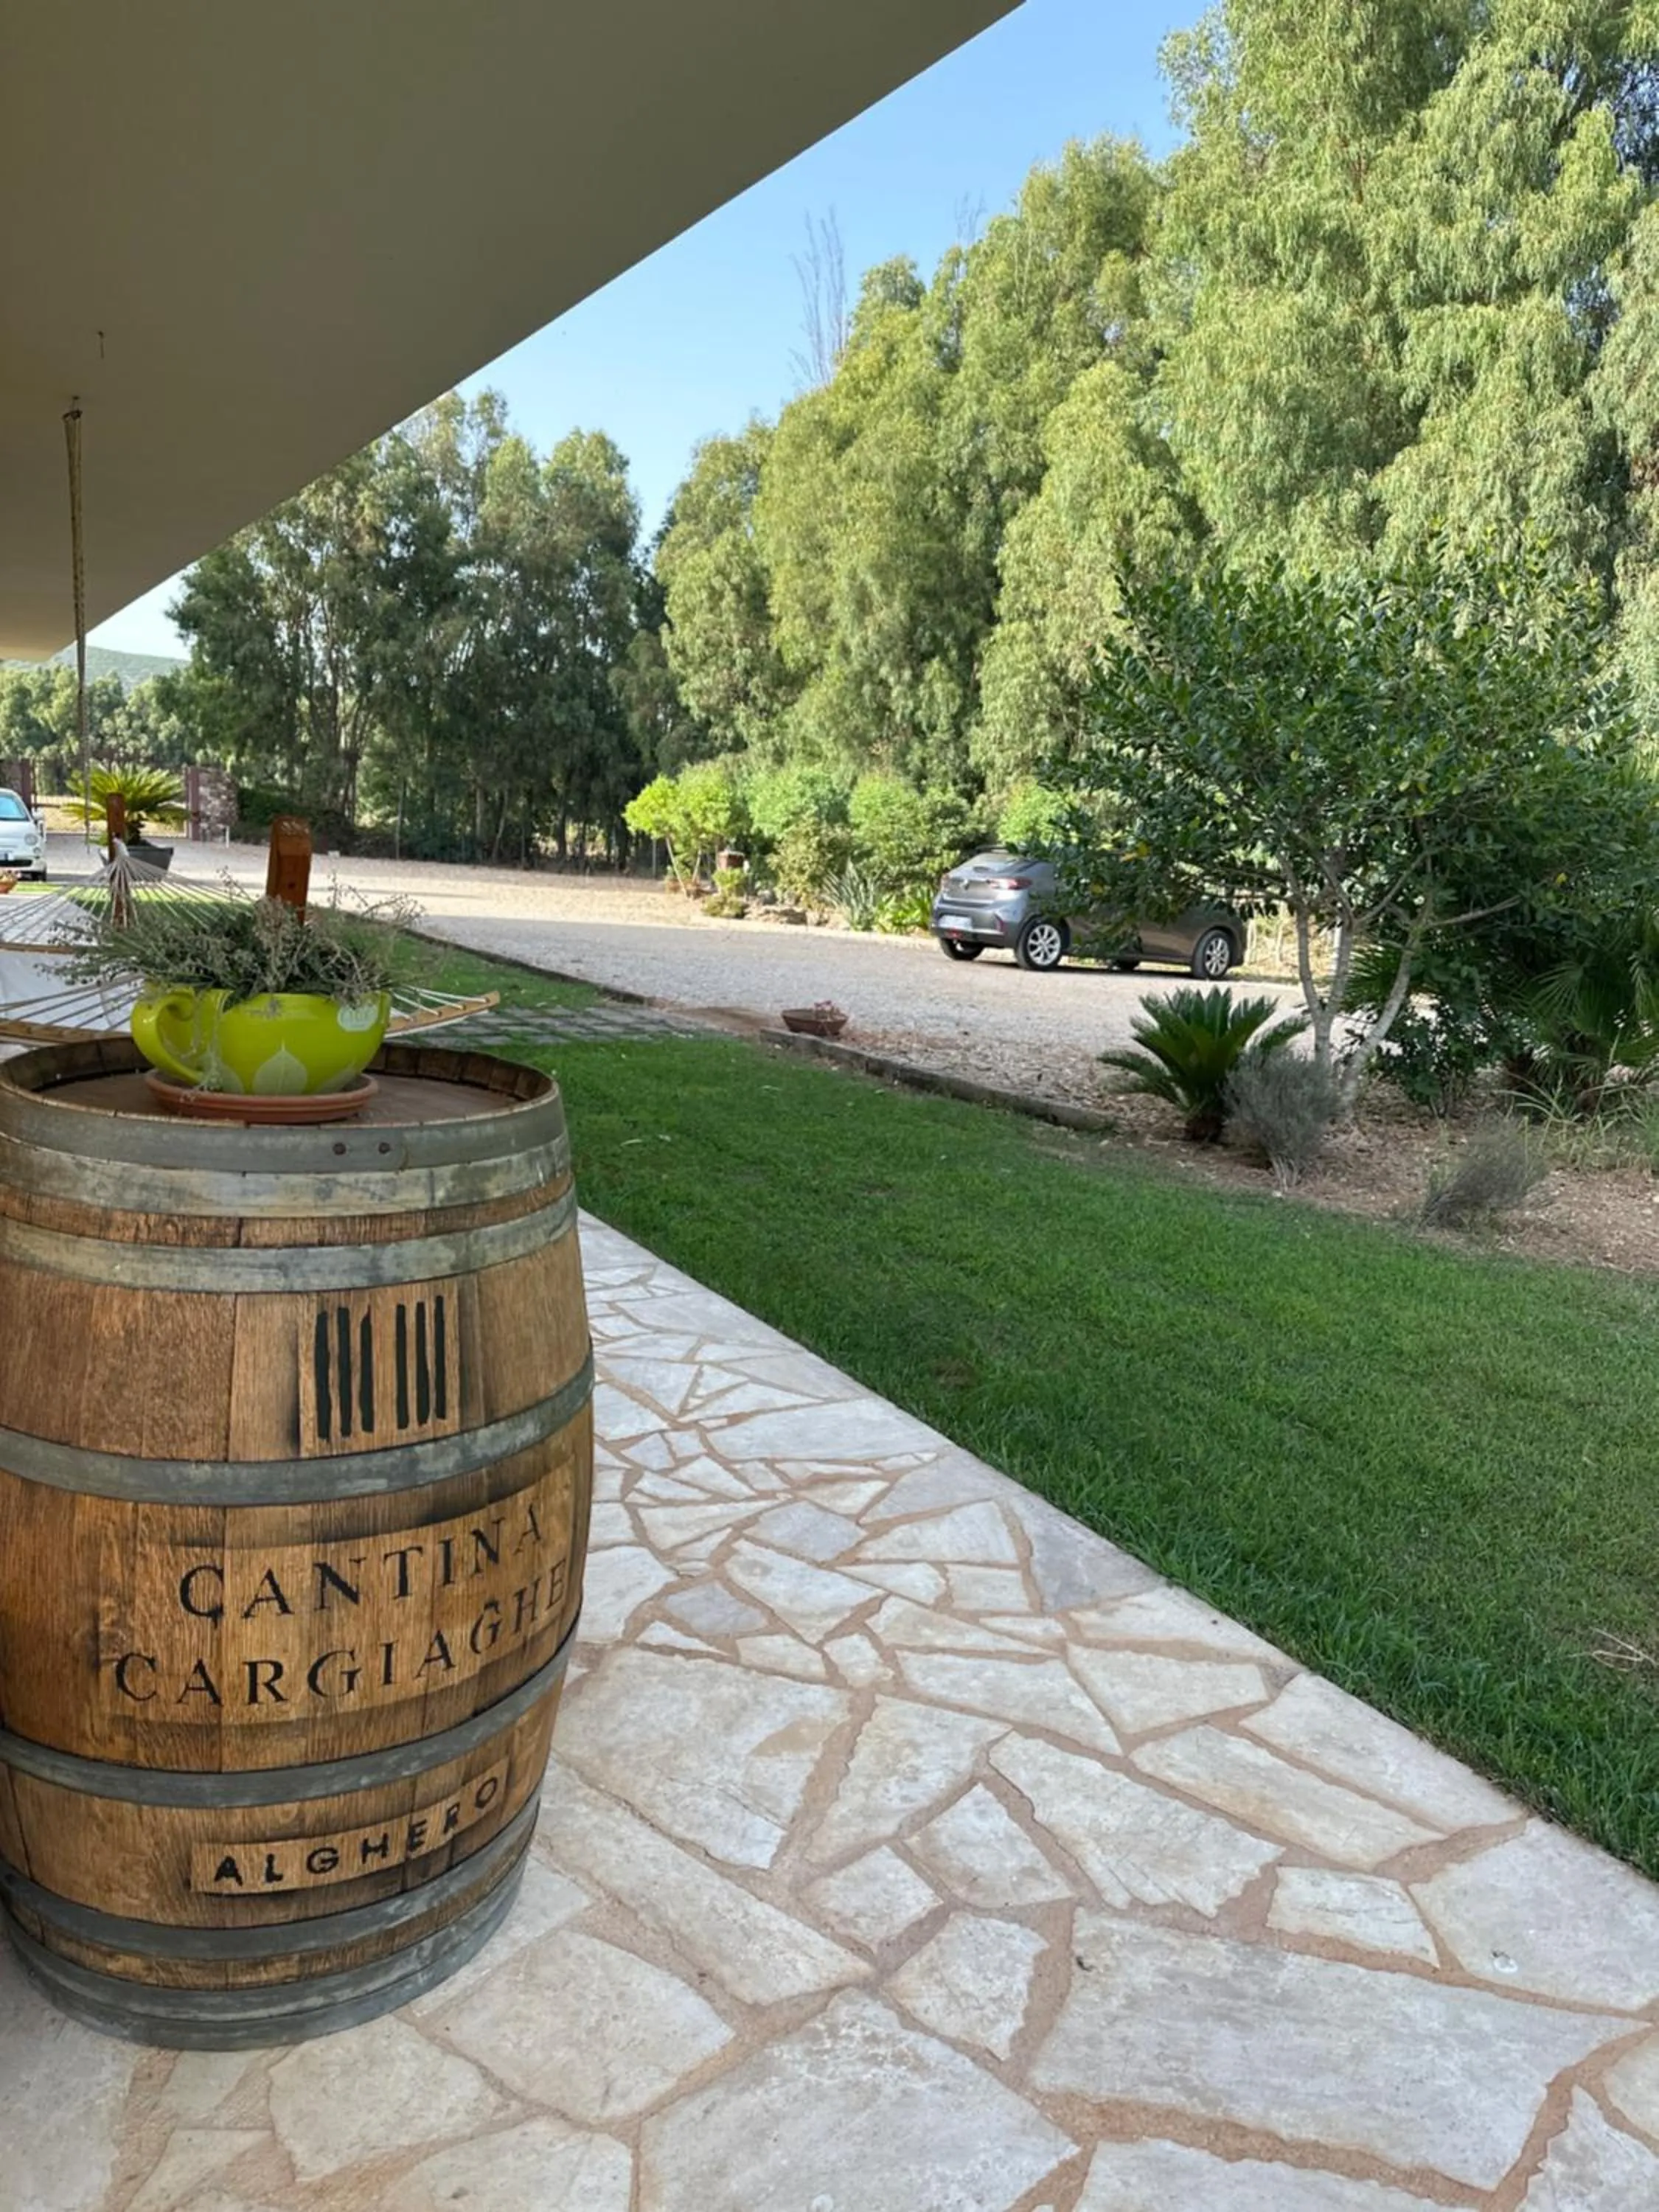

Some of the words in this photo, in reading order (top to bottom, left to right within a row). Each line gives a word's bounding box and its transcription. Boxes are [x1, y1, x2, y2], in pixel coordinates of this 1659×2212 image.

[179, 1503, 544, 1624] CANTINA
[115, 1559, 567, 1707] CARGIAGHE
[214, 1776, 499, 1886] ALGHERO
